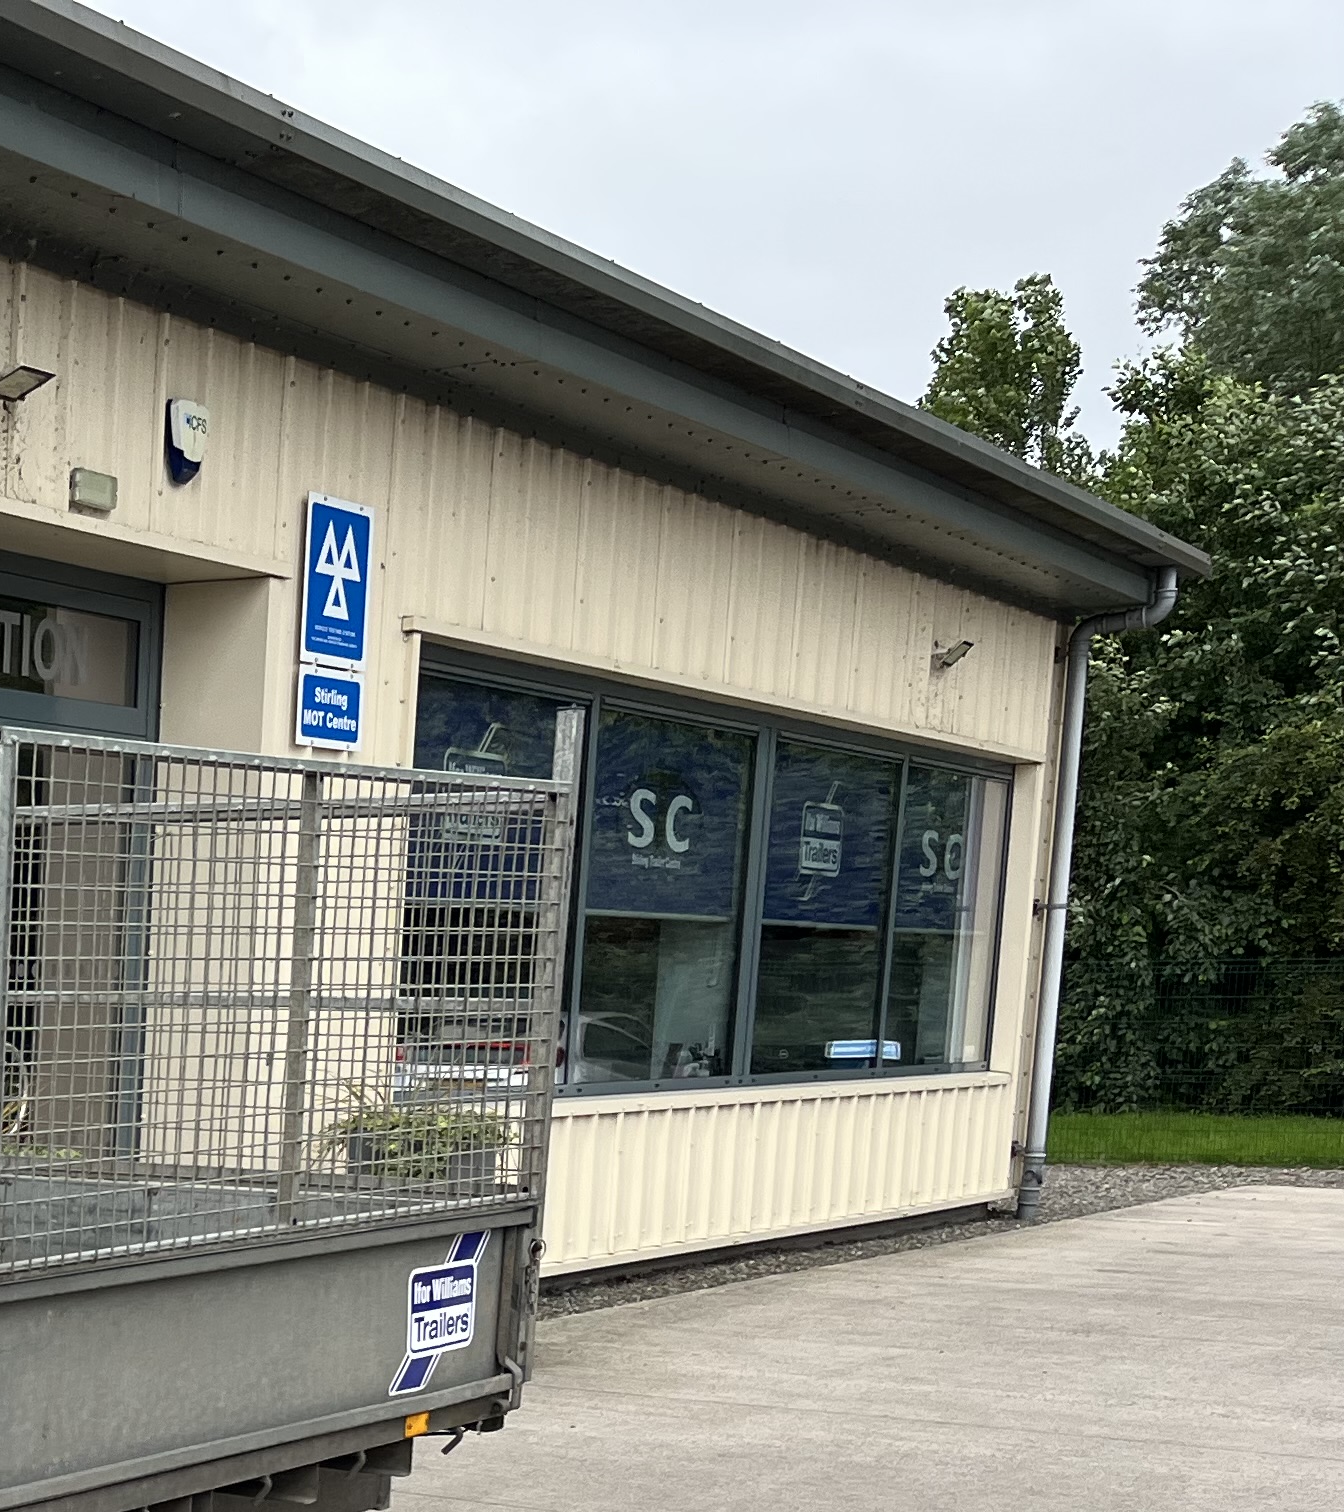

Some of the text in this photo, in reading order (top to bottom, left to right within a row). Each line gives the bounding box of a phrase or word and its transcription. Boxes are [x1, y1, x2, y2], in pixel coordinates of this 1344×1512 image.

[314, 686, 348, 711] Stirling
[303, 708, 357, 732] MOT Centre
[414, 1275, 472, 1305] Ifor Williams
[414, 1312, 469, 1343] Trailers
